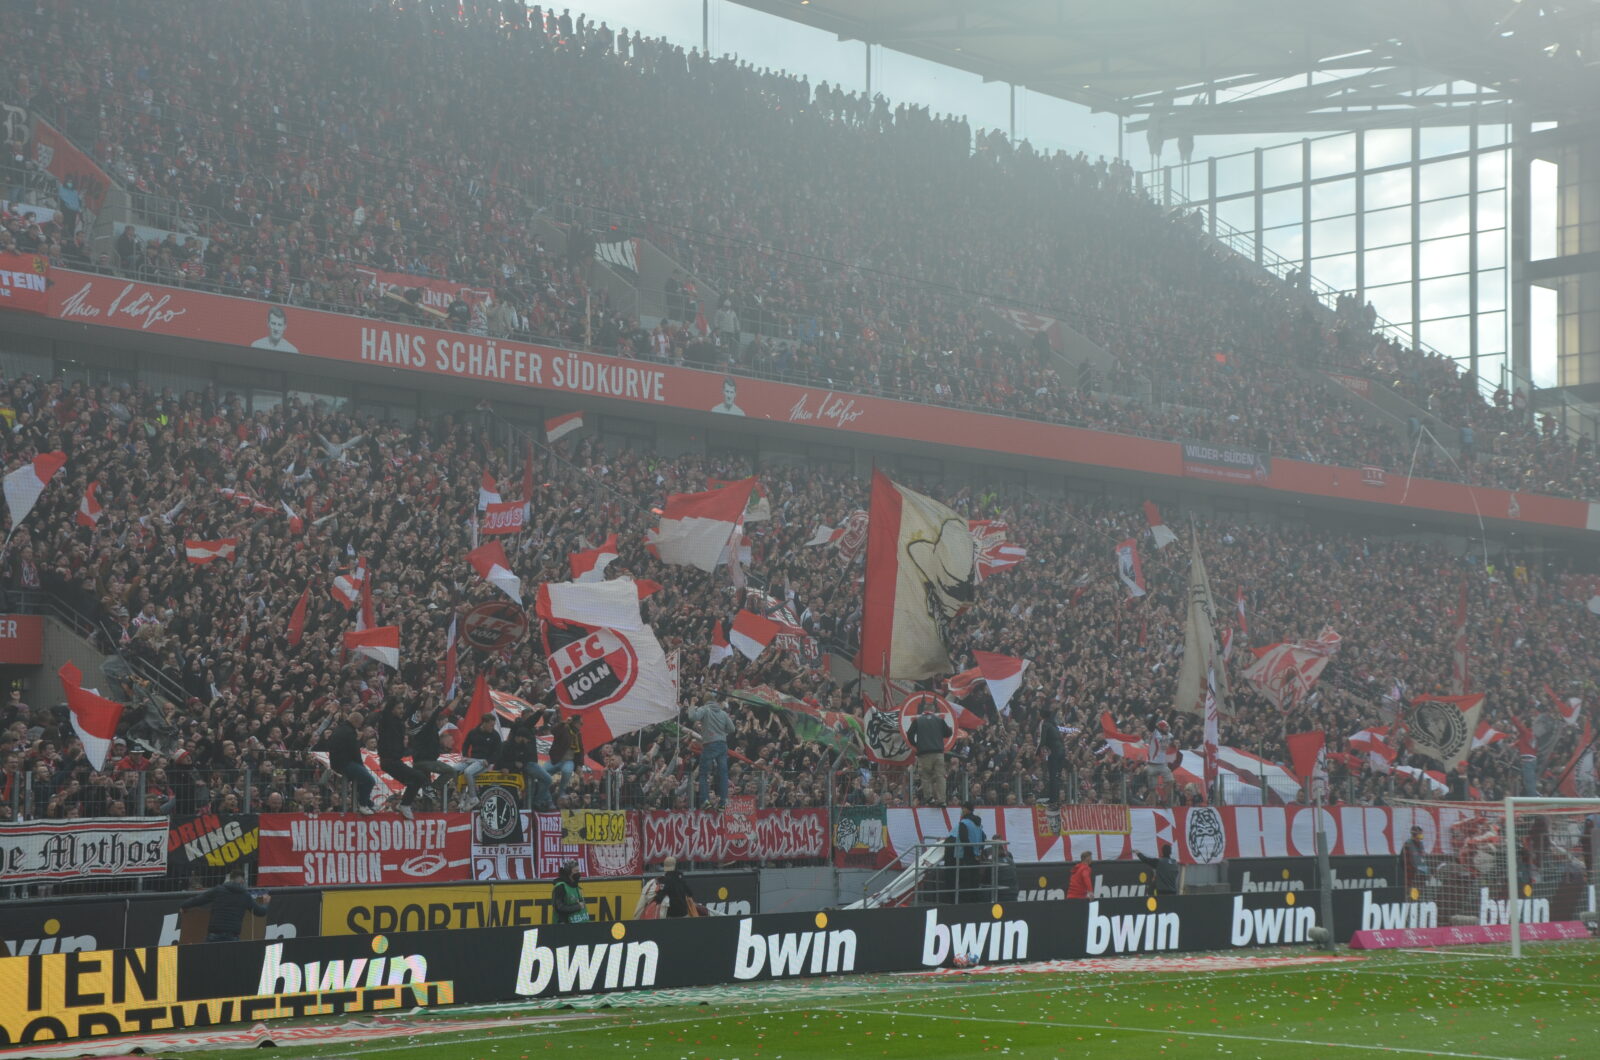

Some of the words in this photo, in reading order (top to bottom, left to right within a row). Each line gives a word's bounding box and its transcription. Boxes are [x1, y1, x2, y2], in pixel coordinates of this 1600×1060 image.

[361, 327, 426, 368] HANS
[435, 339, 543, 384] SCHÄFER
[551, 352, 665, 401] SÜDKURVE
[548, 634, 606, 685] 1.FC
[568, 661, 611, 701] KÖLN
[168, 814, 220, 852] DRIN
[184, 821, 243, 863] KING
[205, 826, 259, 867] NOW
[290, 812, 447, 852] MÜNGERSDORFER
[584, 812, 609, 842] DES
[36, 832, 165, 875] Mythos
[304, 851, 382, 885] STADION
[1086, 896, 1180, 956] bwin
[1231, 891, 1317, 947] bwin
[1361, 886, 1438, 930] bwin
[733, 911, 857, 981] bwin
[921, 903, 1029, 967] bwin
[257, 934, 428, 996] bwin
[514, 921, 660, 997] bwin
